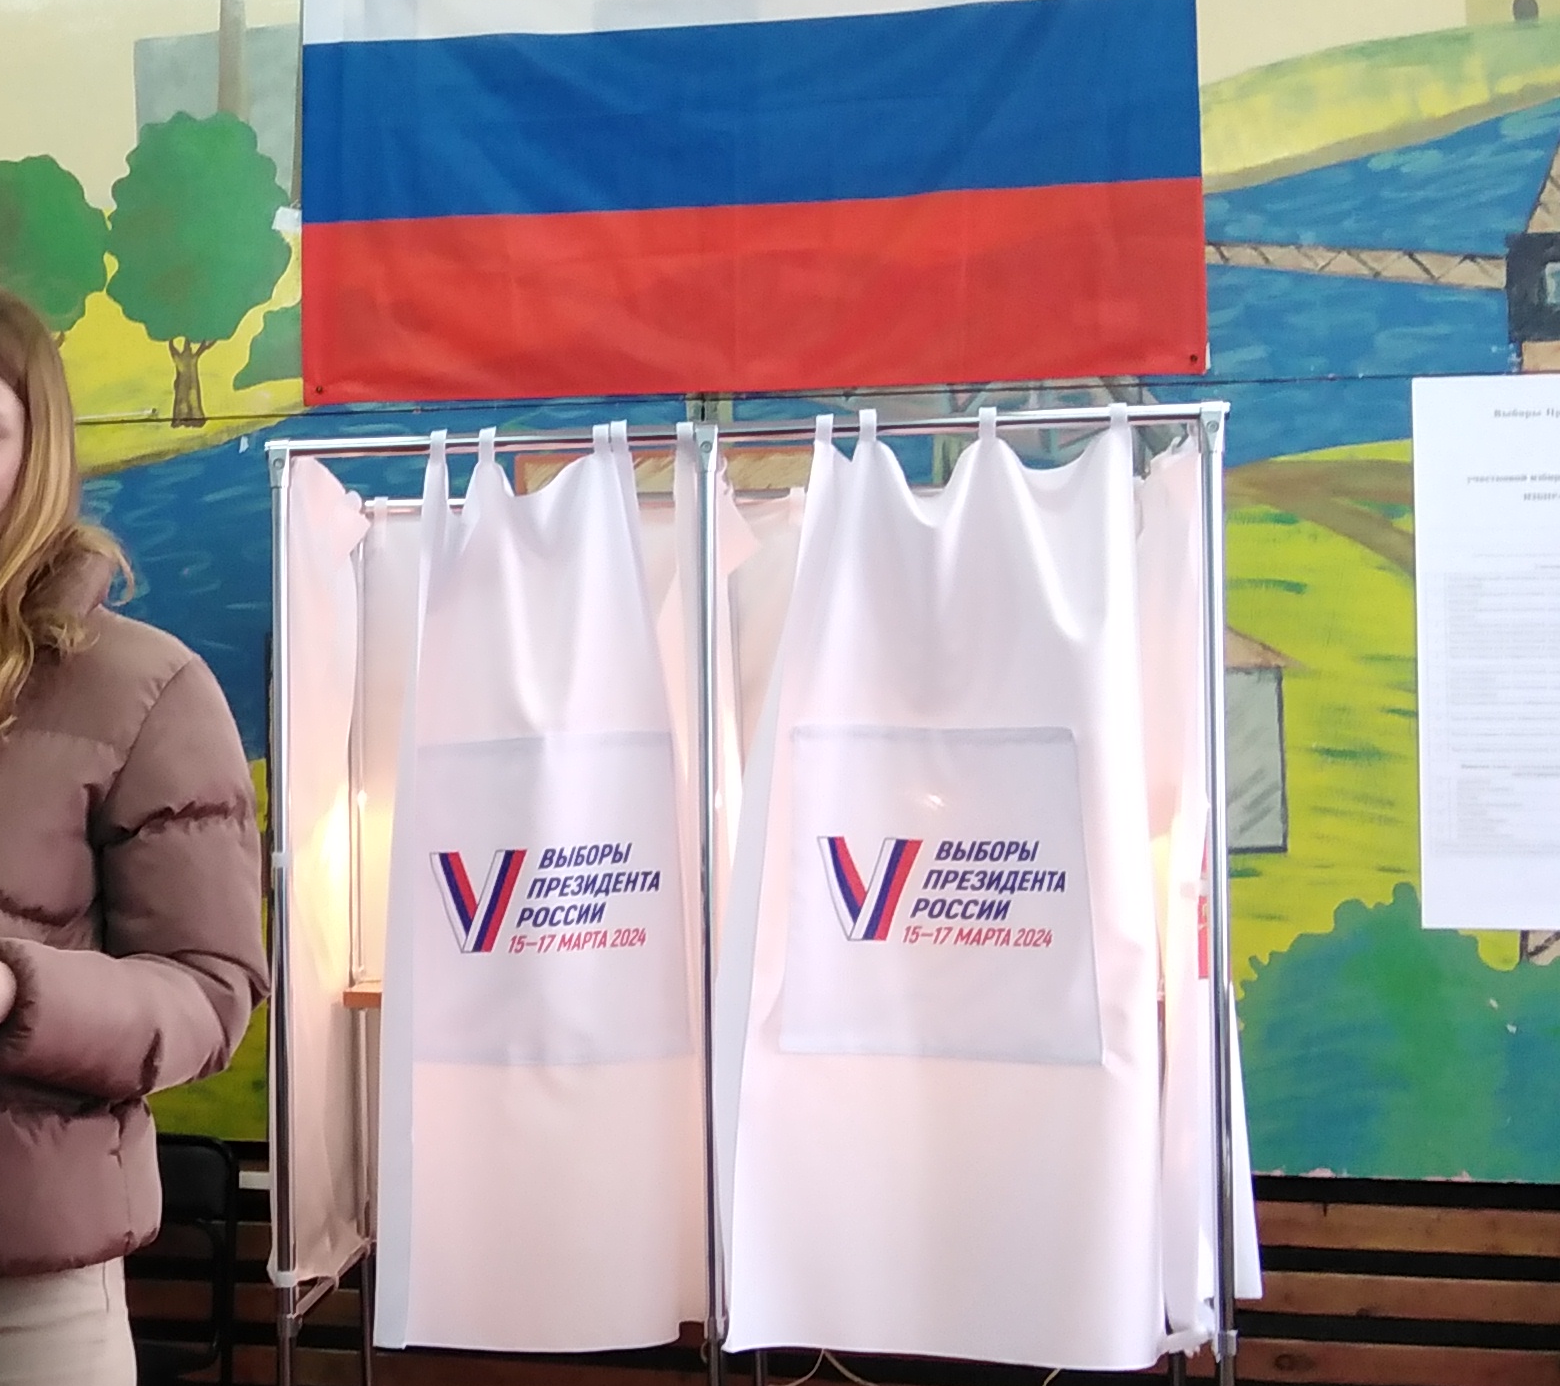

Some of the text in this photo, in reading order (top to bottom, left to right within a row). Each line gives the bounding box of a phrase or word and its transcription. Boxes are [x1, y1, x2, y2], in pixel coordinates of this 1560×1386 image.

[537, 842, 633, 870] ВЫБОРЫ
[934, 840, 1040, 863] ВЫБОРЫ
[526, 870, 661, 900] ПРЕЗИДЕНТА
[922, 869, 1067, 895] ПРЕЗИДЕНТА
[515, 901, 607, 929] РОССИИ
[909, 897, 1012, 921] РОССИИ
[556, 929, 608, 953] МАРТА
[610, 927, 647, 948] 2024
[953, 927, 1012, 947] МАРТА
[1013, 927, 1053, 948] 2024
